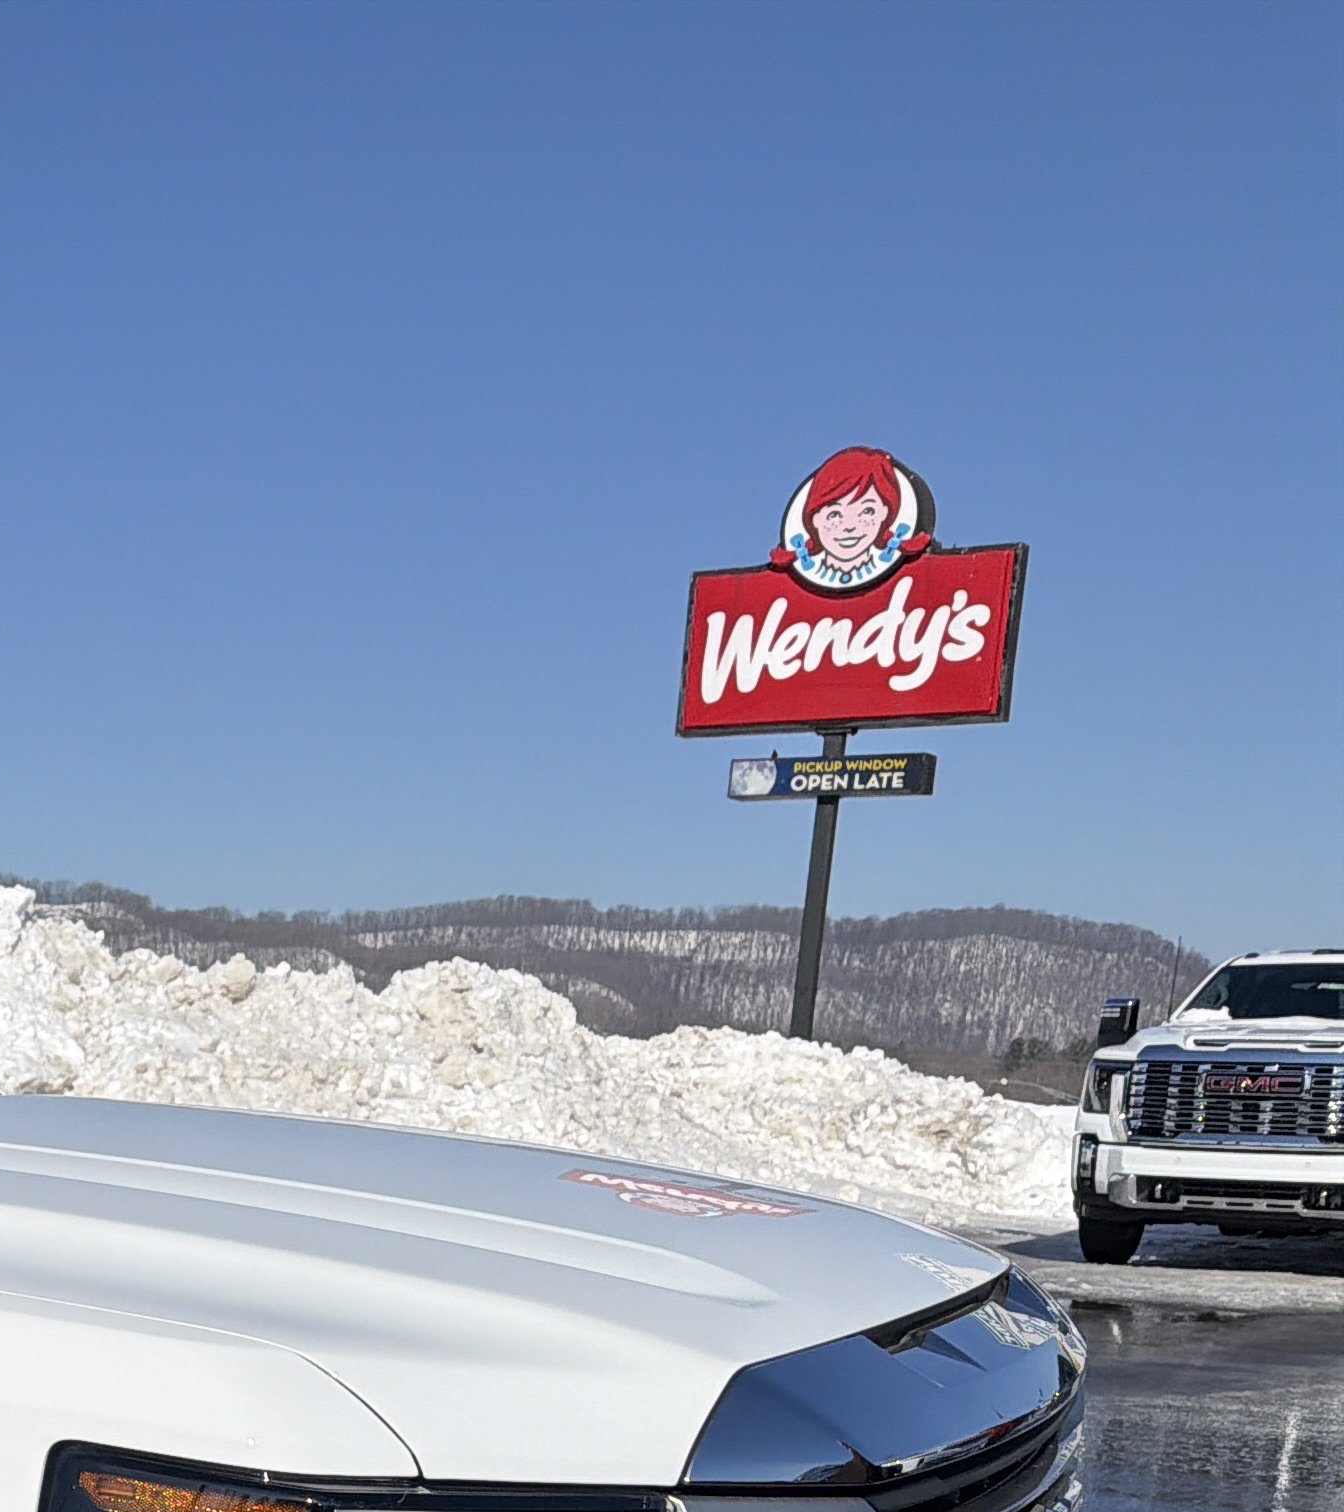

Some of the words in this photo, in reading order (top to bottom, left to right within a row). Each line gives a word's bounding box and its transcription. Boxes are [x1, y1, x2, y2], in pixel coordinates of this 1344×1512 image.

[701, 576, 991, 704] Wendy's
[793, 759, 843, 773] PICKUP
[845, 758, 908, 772] WINDOW
[790, 773, 849, 792] OPEN
[852, 771, 906, 790] LATE
[1205, 1075, 1303, 1093] GMC
